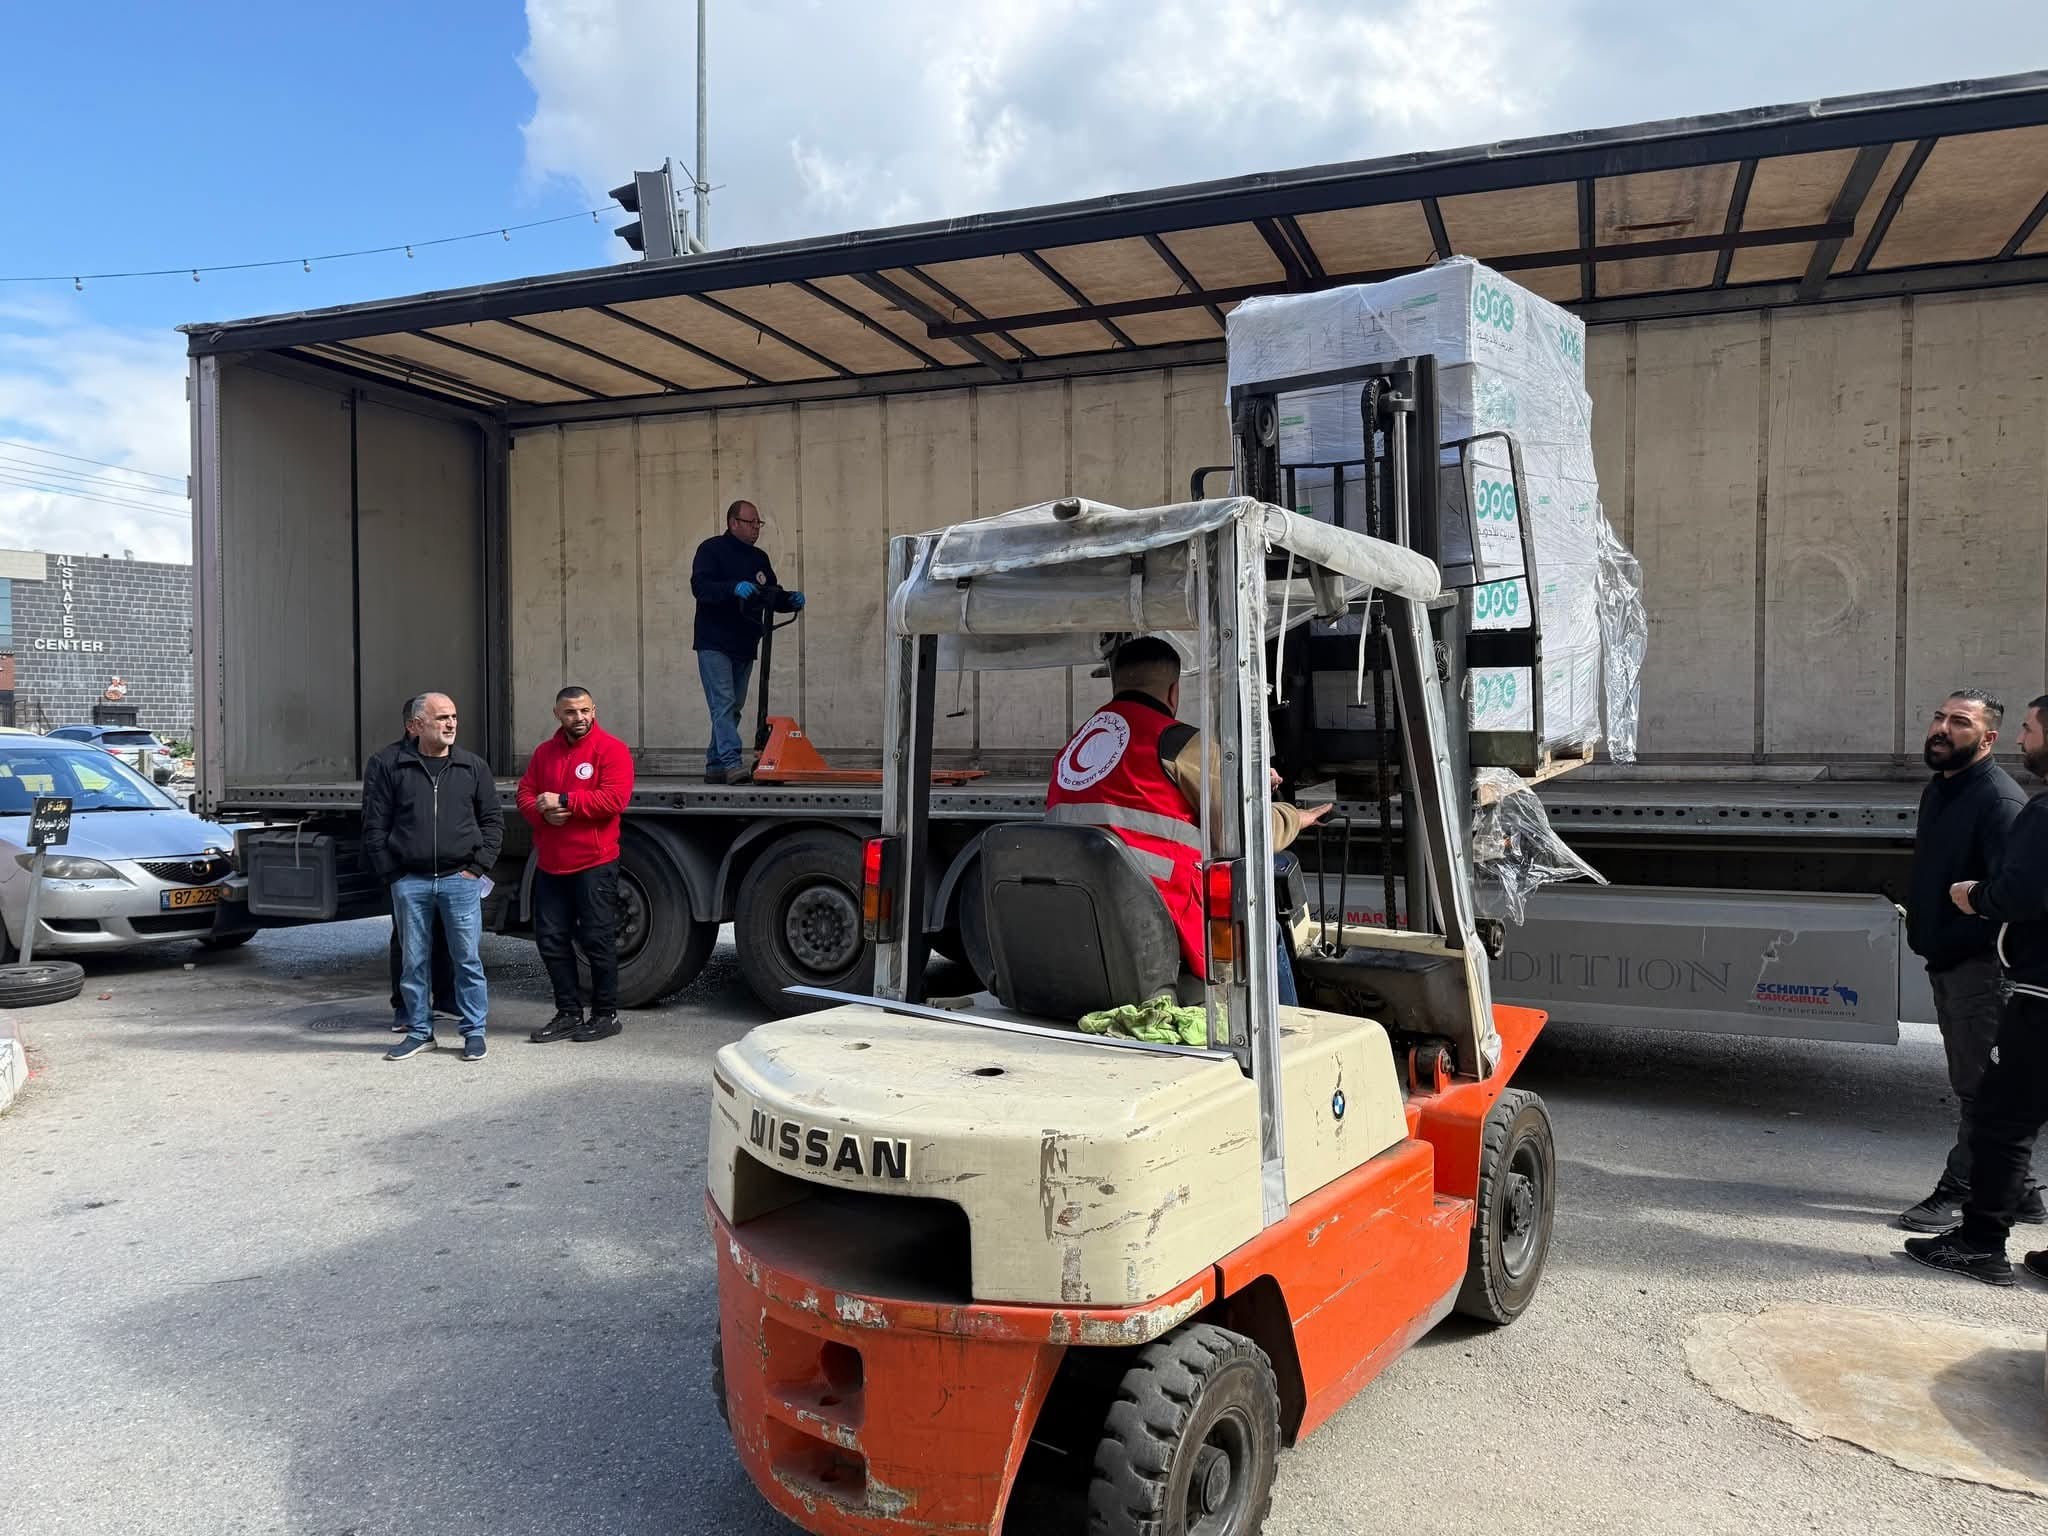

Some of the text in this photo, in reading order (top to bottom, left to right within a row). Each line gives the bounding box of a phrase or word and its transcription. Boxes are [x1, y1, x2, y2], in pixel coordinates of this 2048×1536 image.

[1476, 479, 1516, 521] bpc
[34, 638, 103, 652] CENTER
[1098, 751, 1119, 776] SOCIETY
[1501, 951, 1732, 992] DITION
[1756, 983, 1830, 996] SCHMITZ
[1756, 993, 1831, 1005] CARGOBULL
[750, 1106, 911, 1181] NISSAN
